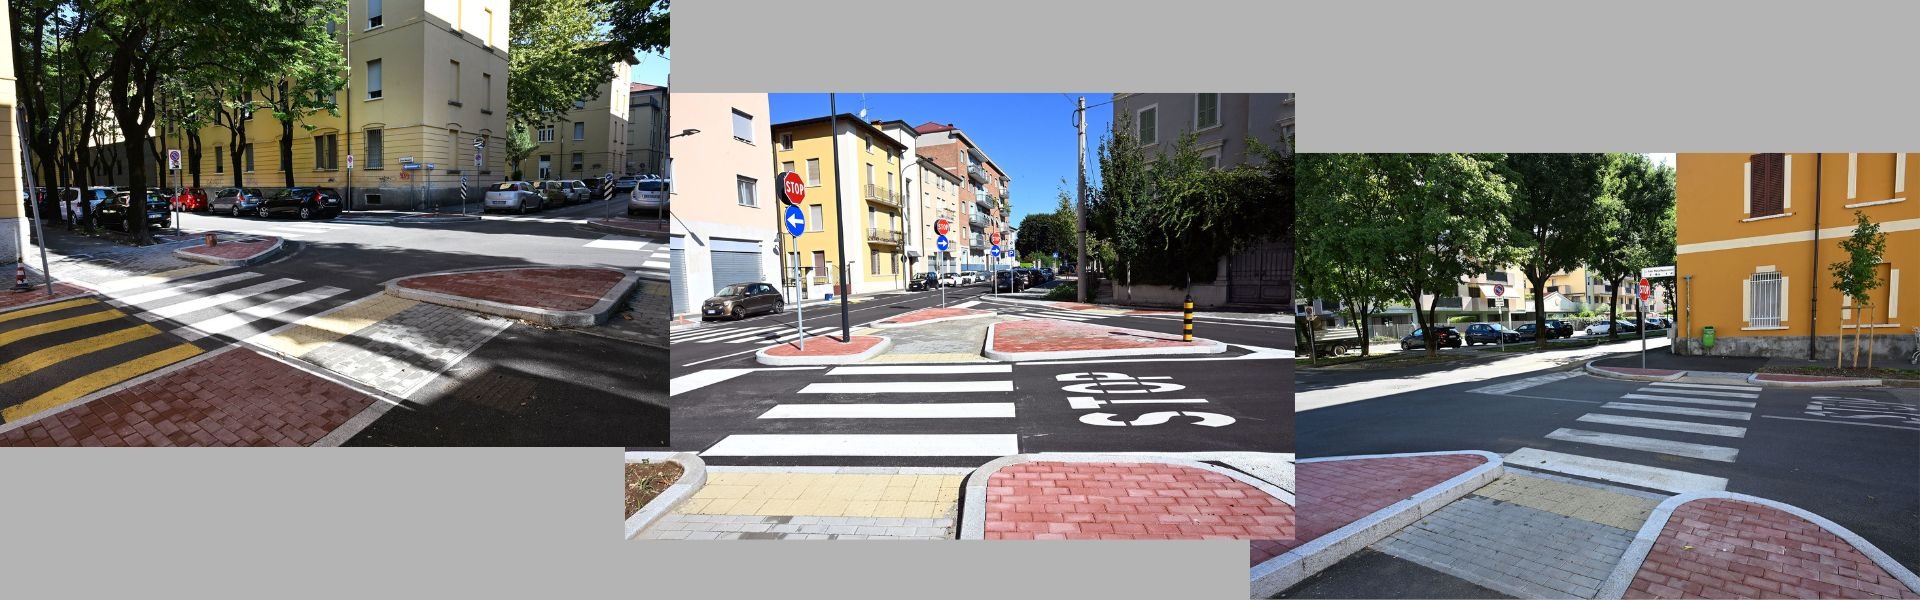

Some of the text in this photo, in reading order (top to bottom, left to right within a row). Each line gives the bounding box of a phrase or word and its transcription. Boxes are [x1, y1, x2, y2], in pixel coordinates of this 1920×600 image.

[786, 181, 804, 195] STOP
[937, 223, 949, 231] STOP
[1639, 285, 1649, 294] STOP
[1055, 372, 1236, 427] STOP
